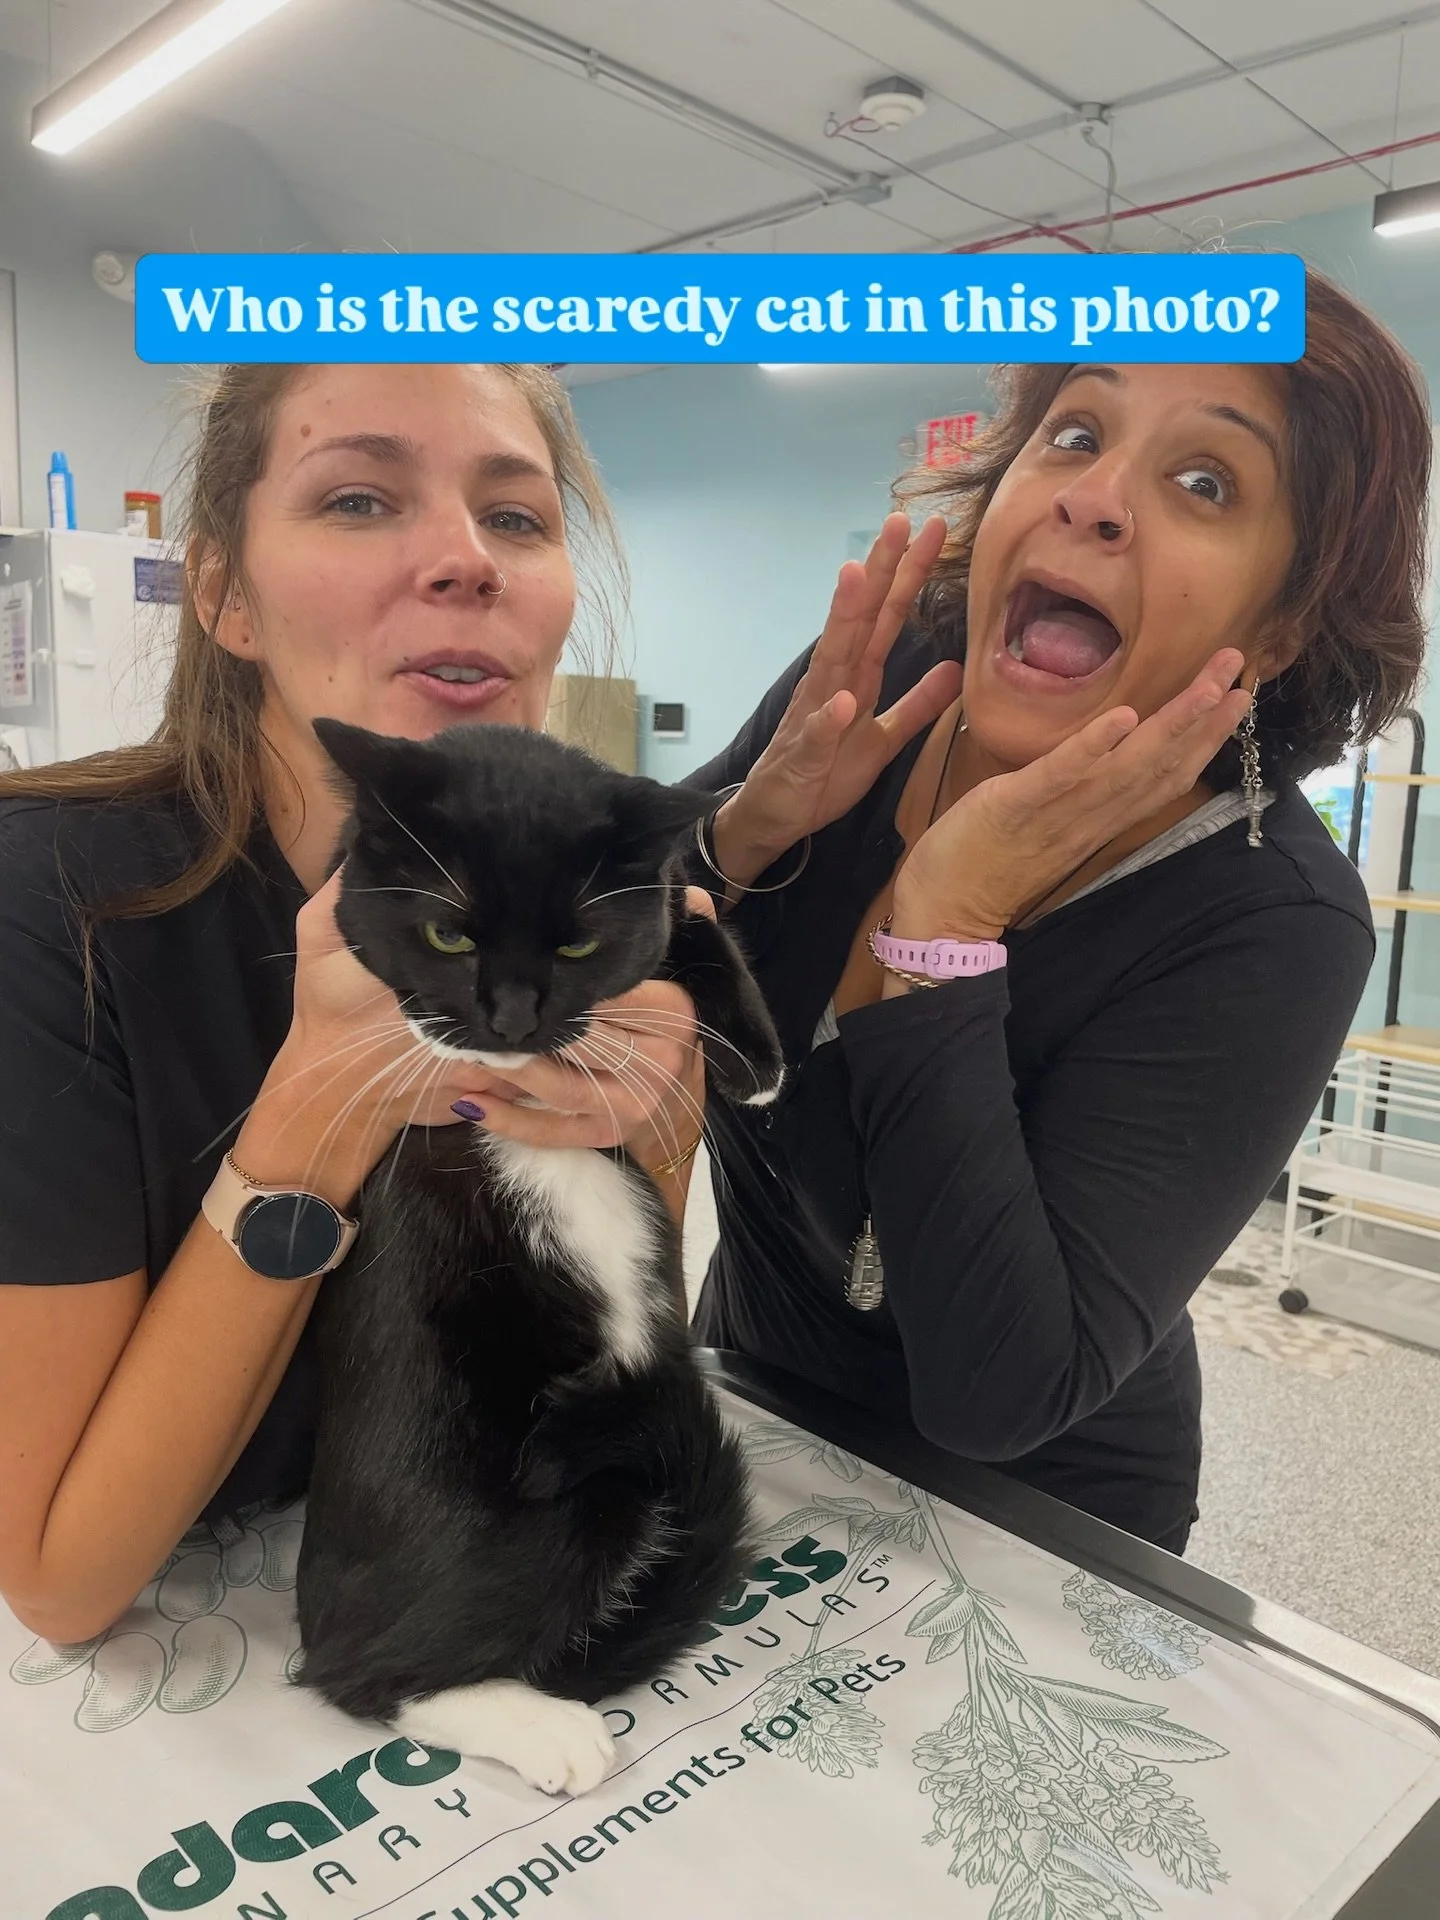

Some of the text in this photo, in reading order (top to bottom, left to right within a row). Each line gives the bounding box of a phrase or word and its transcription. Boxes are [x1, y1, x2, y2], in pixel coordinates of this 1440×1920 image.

[416, 1654, 906, 1920] upplements for Pets
